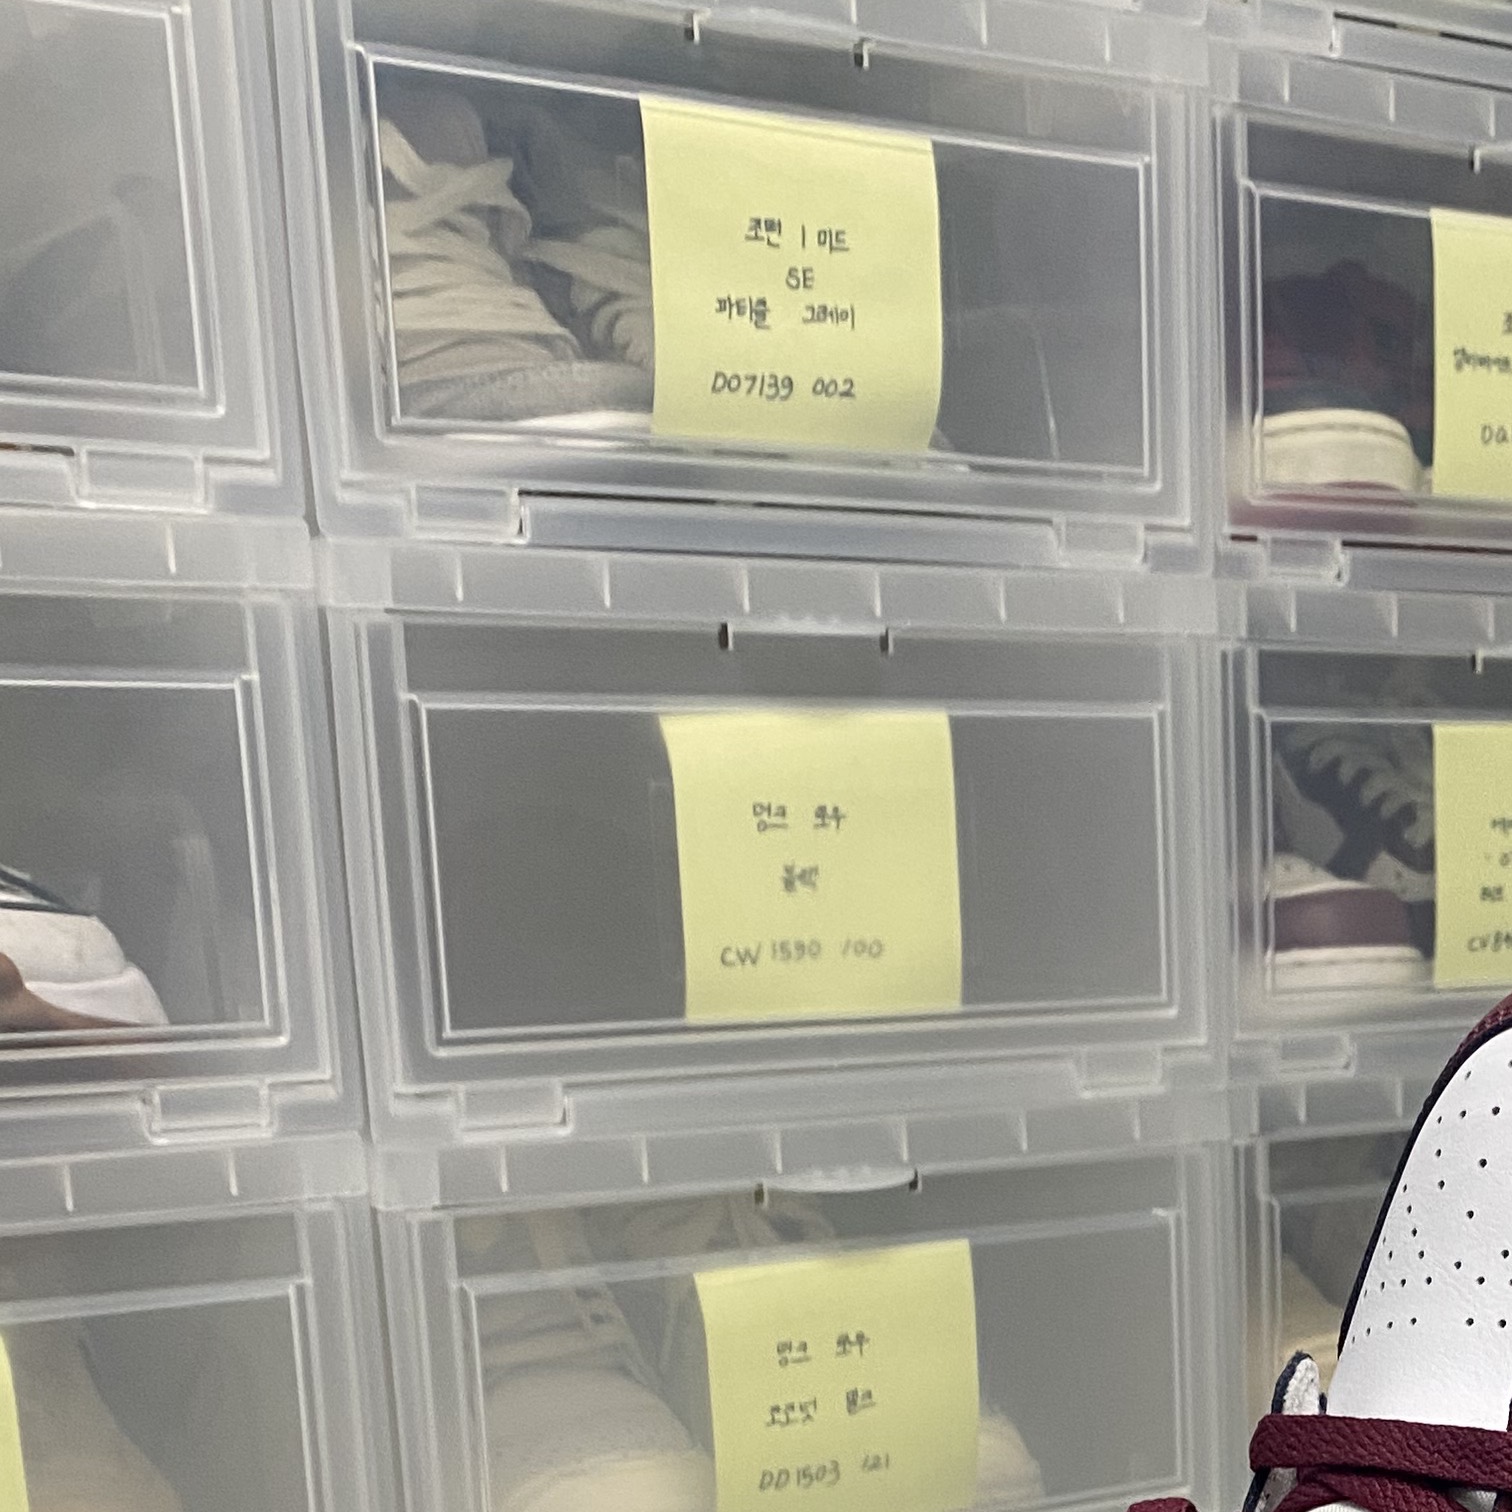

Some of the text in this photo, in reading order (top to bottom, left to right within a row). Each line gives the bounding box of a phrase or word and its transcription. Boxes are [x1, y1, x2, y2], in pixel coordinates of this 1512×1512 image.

[816, 228, 850, 255] 미드
[785, 266, 815, 291] SE
[715, 294, 856, 331] 파티클 그레이
[811, 377, 857, 400] 002
